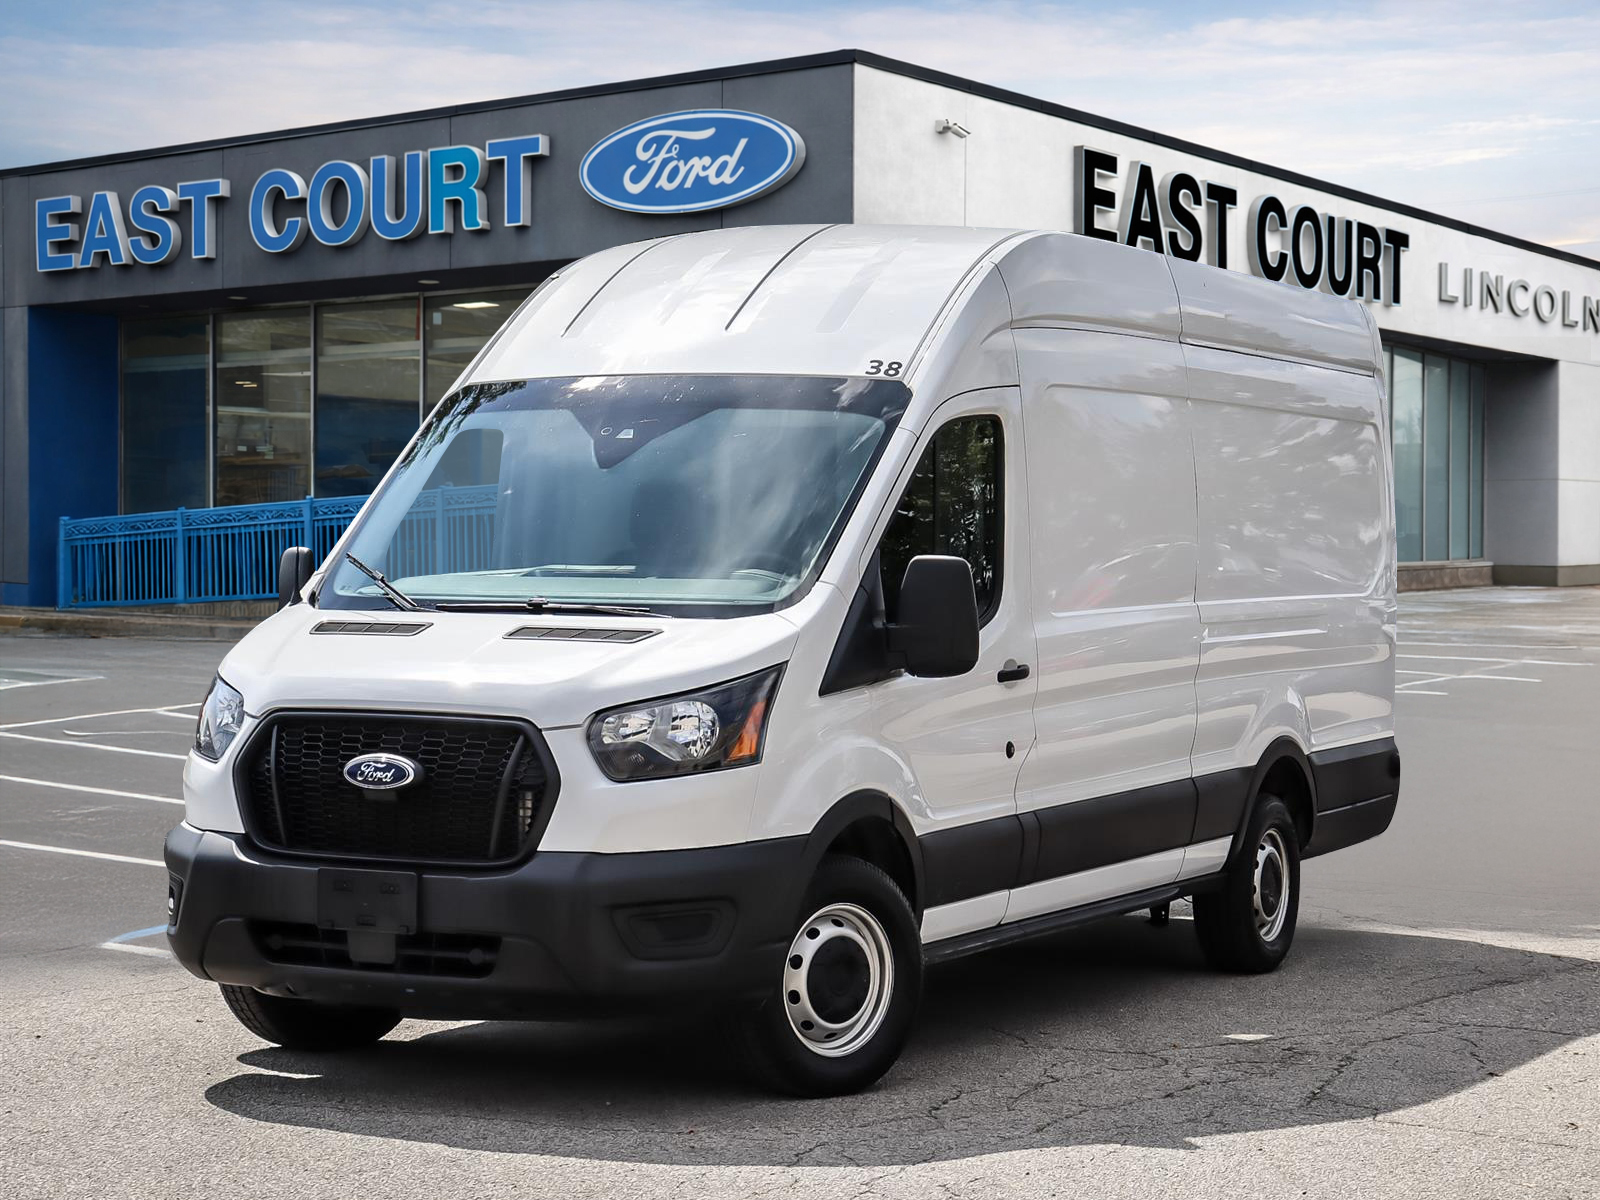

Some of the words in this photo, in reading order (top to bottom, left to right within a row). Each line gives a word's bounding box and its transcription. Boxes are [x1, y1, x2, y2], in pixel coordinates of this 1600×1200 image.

[623, 127, 749, 195] Ford
[36, 179, 229, 272] EAST
[249, 133, 550, 253] COURT
[1074, 145, 1238, 270] EAST
[1247, 194, 1410, 307] COURT
[1438, 262, 1600, 334] LINCOLN
[865, 359, 903, 377] 38
[356, 761, 396, 782] Ford
